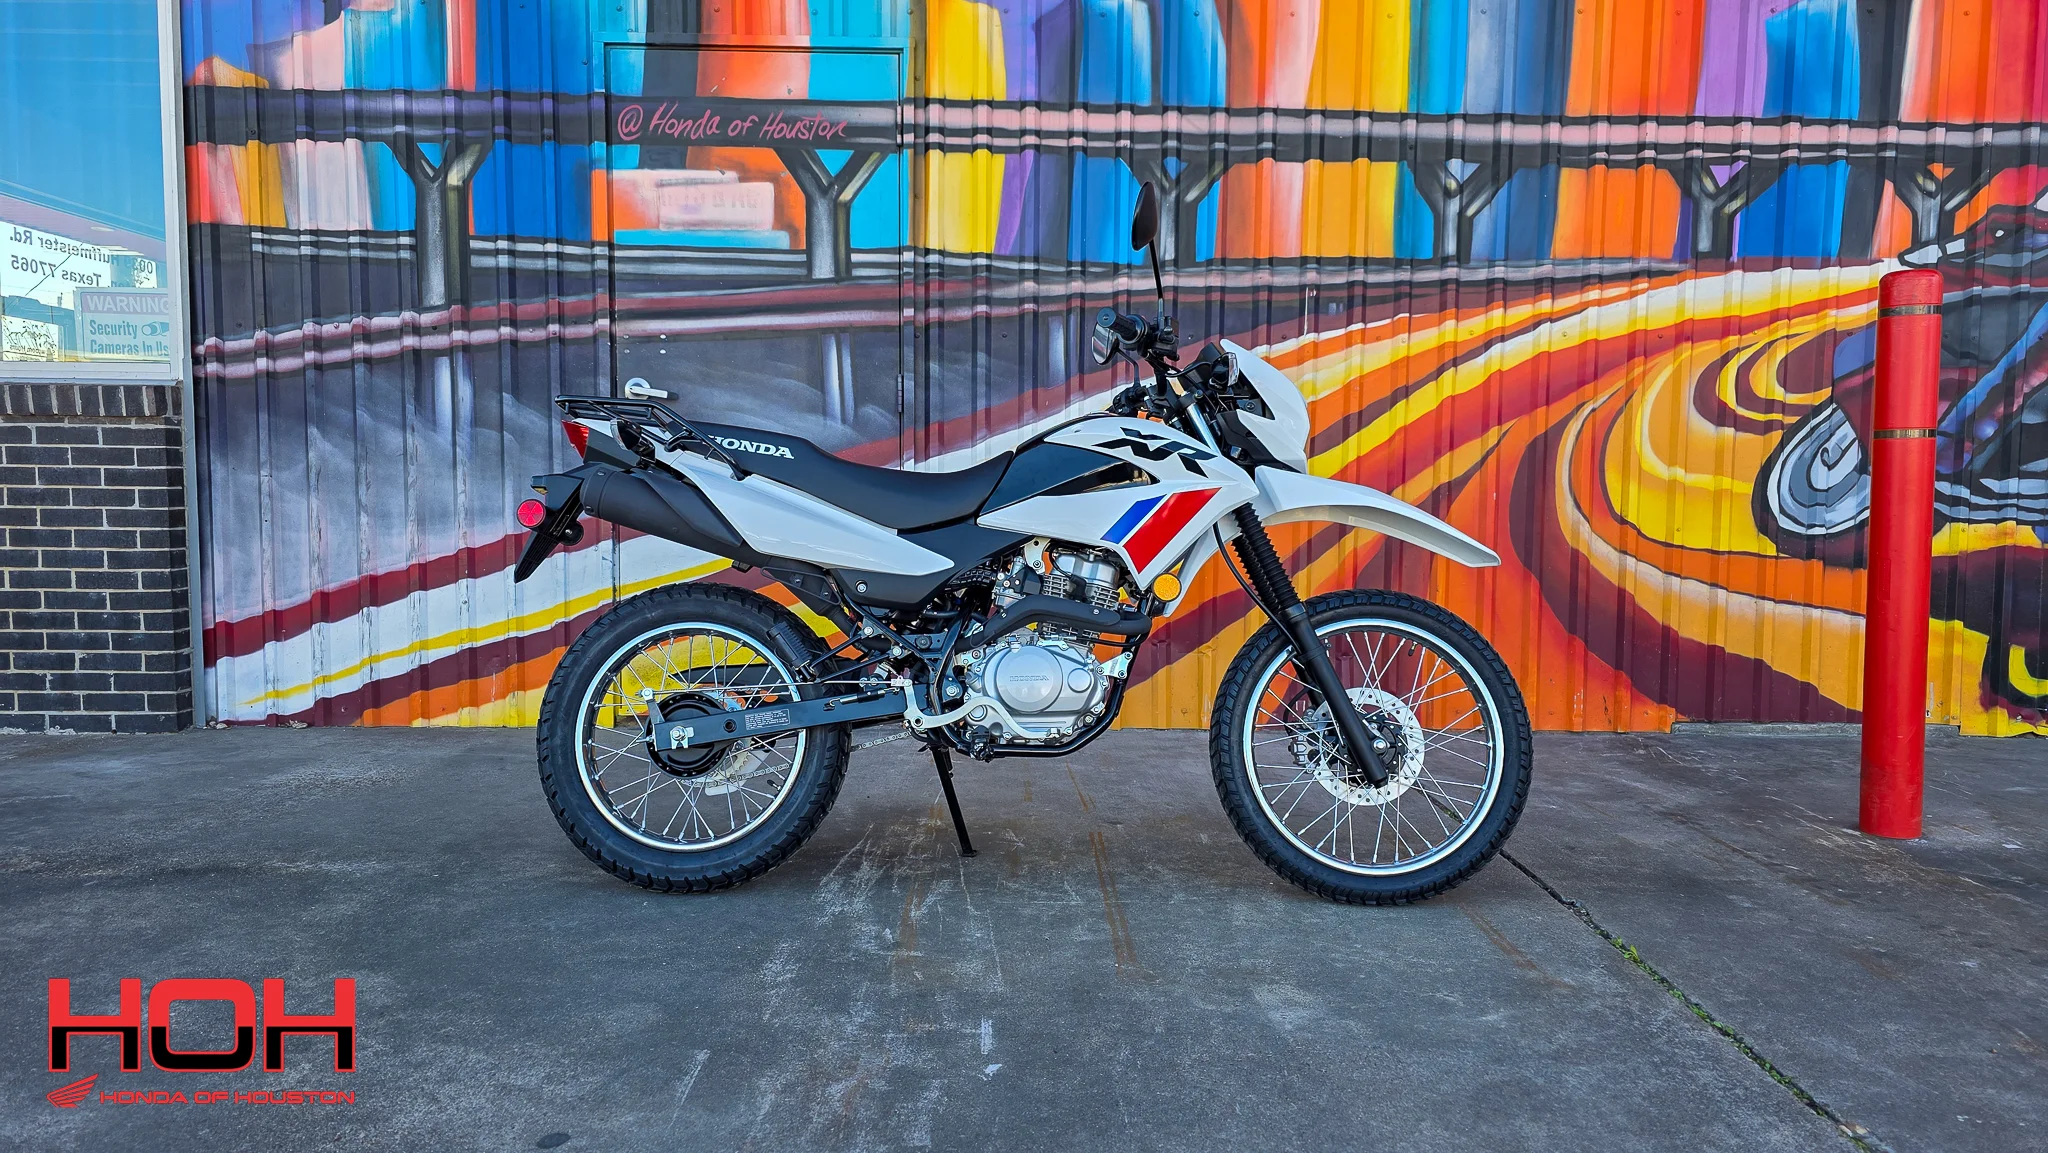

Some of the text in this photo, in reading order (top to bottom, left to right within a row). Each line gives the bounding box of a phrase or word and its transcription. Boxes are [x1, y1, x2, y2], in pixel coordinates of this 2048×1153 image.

[617, 100, 848, 141] @ Honda of Houston
[86, 295, 168, 313] WARNING
[89, 319, 138, 339] Security
[90, 339, 169, 357] Cameras In Us
